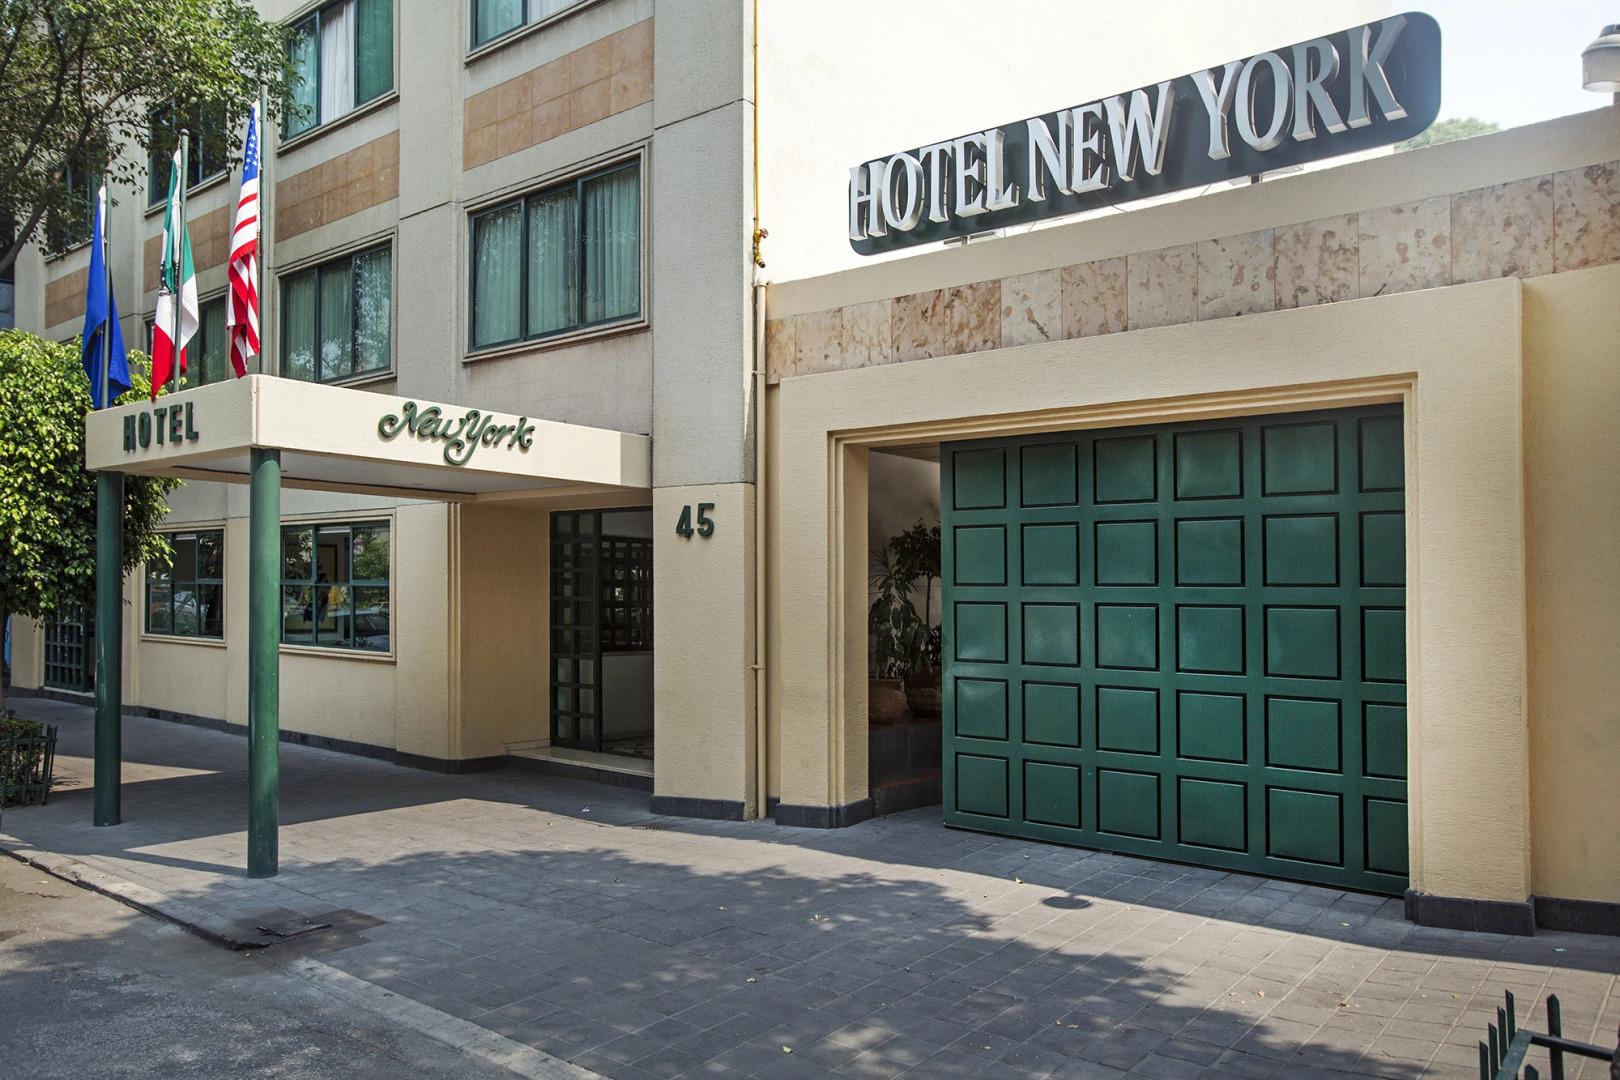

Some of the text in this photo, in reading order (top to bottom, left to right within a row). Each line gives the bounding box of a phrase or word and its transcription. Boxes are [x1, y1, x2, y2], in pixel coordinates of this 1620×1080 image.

[849, 14, 1408, 241] HOTEL NEW YORK
[123, 401, 200, 451] HOTEL
[378, 401, 536, 466] New York
[675, 502, 715, 539] 45
